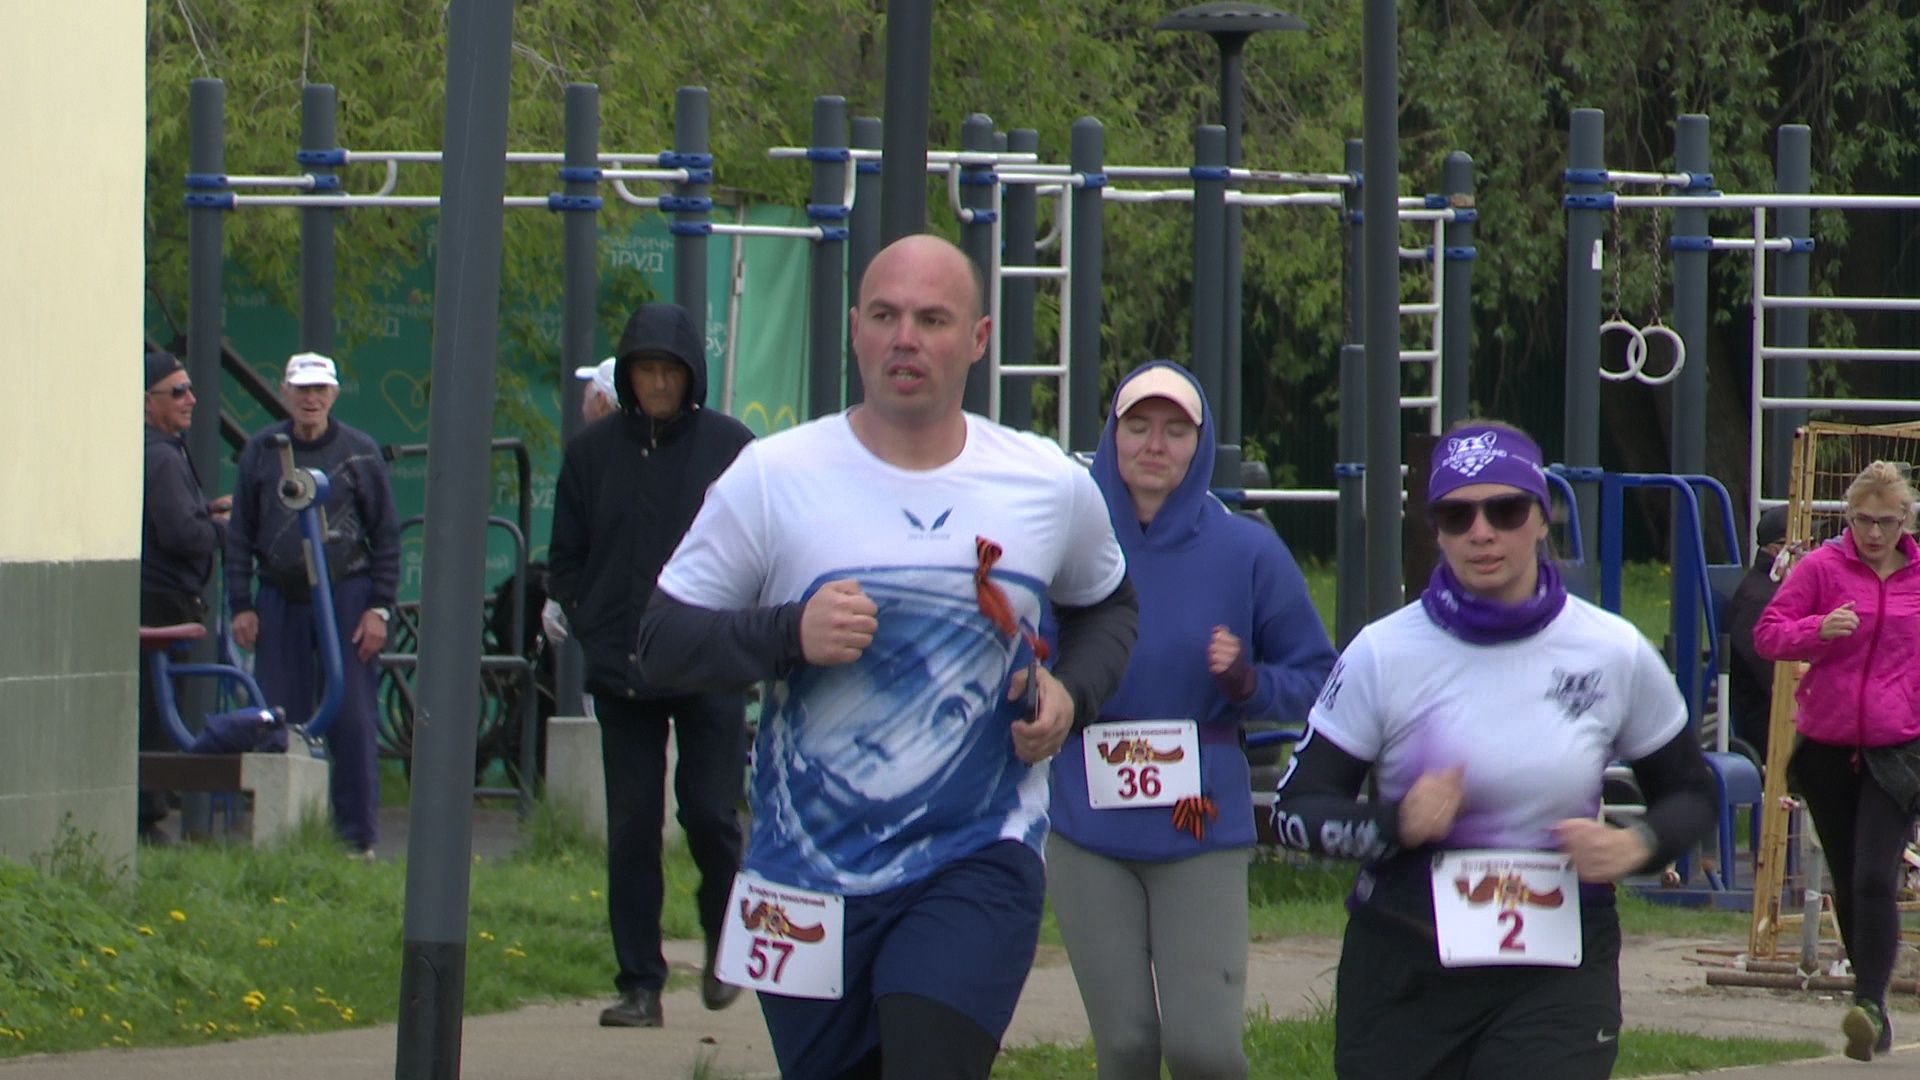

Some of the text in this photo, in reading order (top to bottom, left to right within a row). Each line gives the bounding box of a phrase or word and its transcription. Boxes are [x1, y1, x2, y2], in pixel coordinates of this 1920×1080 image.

[1118, 766, 1162, 799] 36
[1498, 910, 1526, 952] 2
[747, 936, 795, 983] 57
